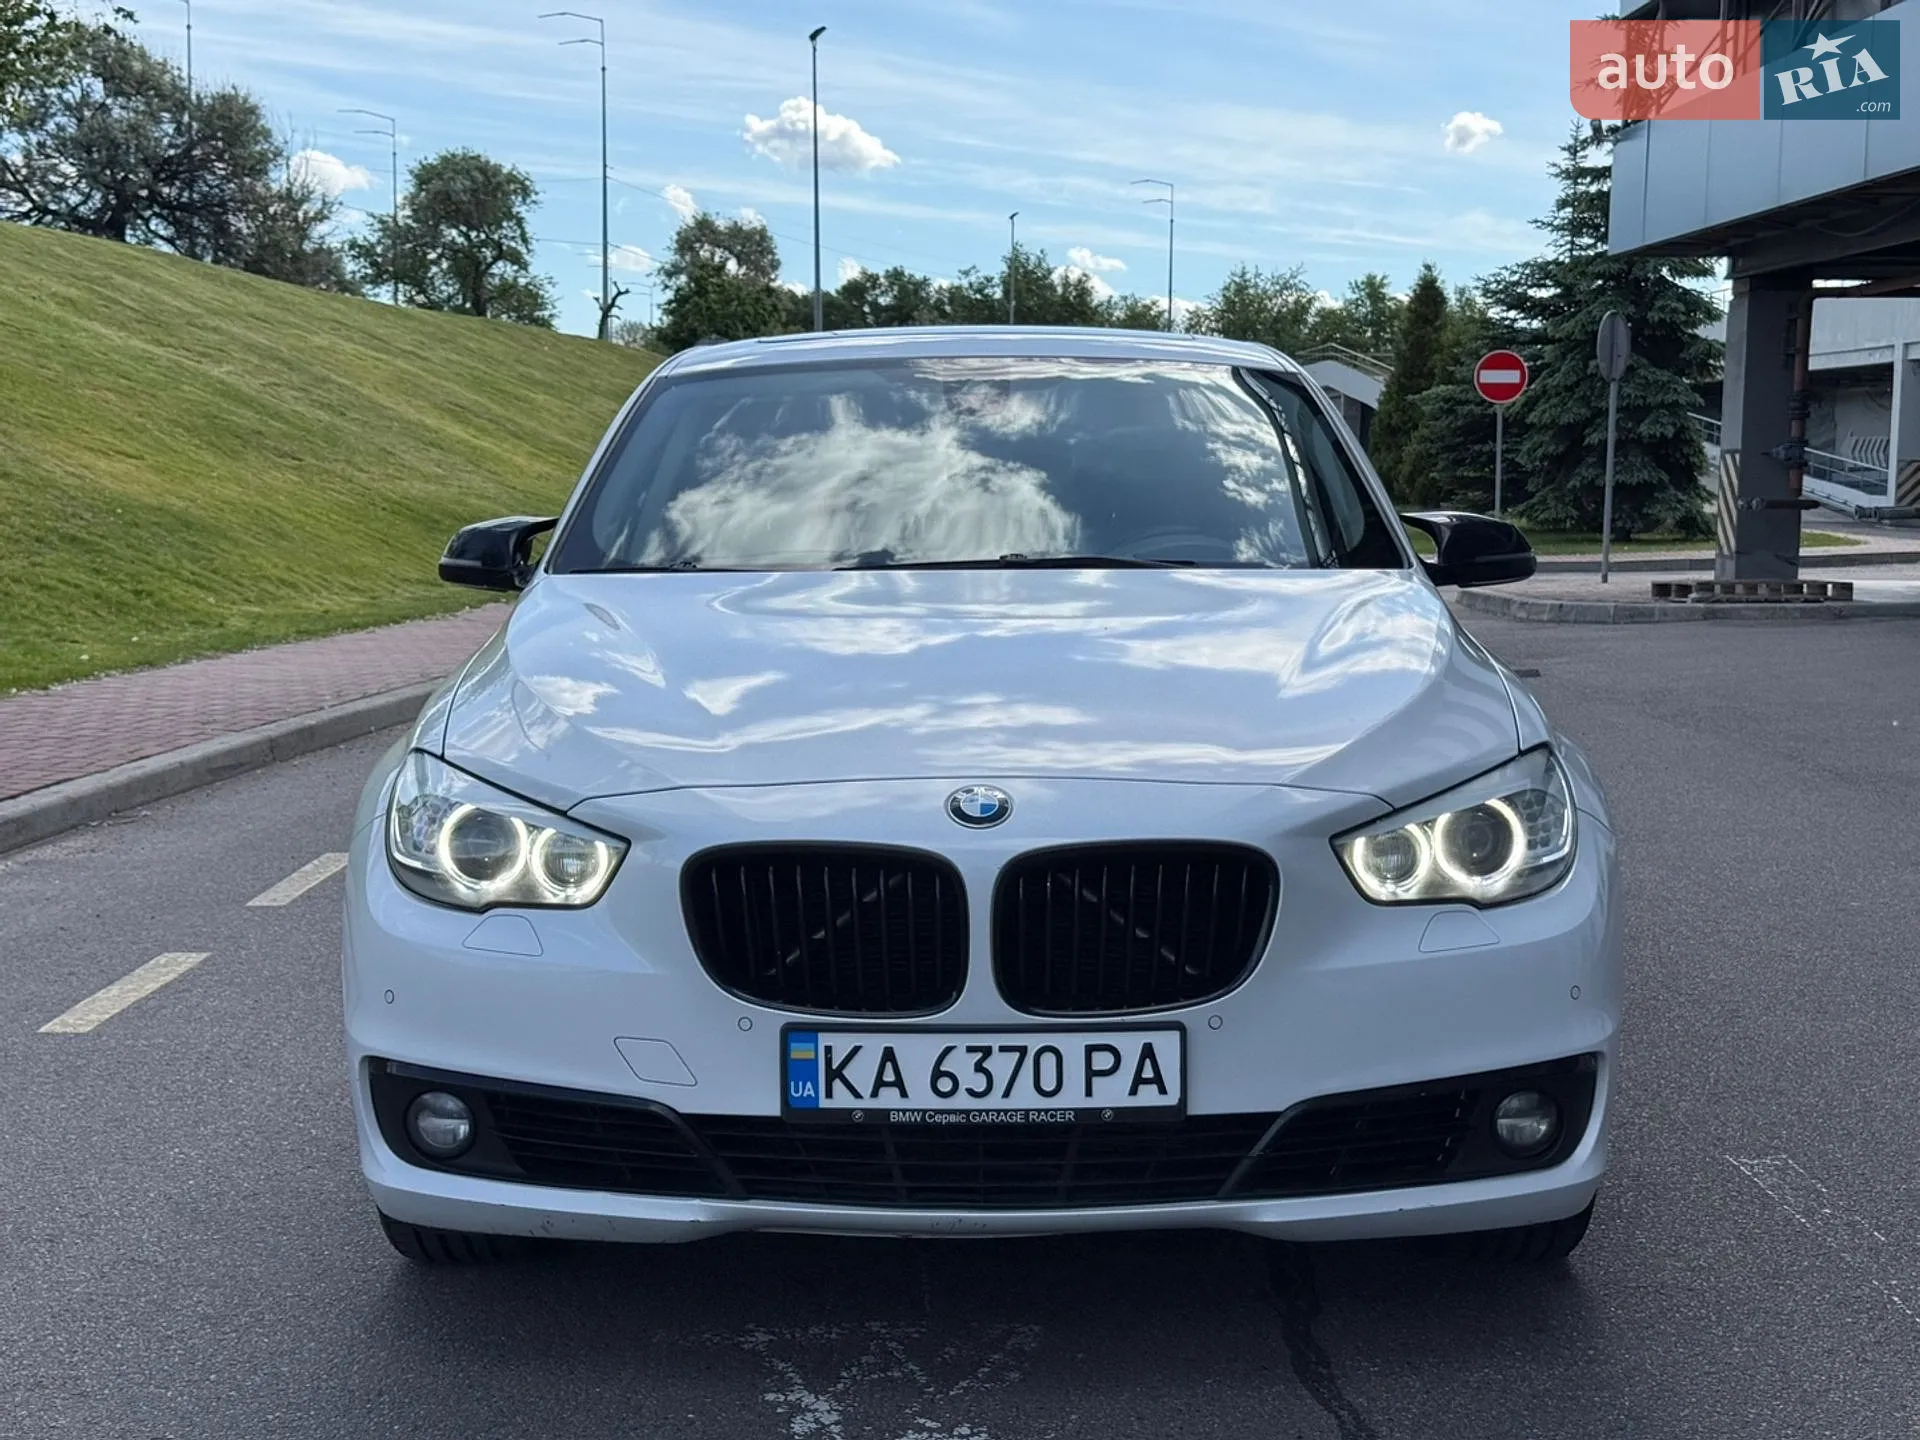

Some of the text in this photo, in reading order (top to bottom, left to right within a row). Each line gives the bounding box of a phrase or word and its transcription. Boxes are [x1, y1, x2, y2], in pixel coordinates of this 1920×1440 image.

[824, 1042, 1168, 1100] KA 6370 PA
[790, 1081, 815, 1098] UA
[890, 1111, 923, 1122] BMW
[969, 1111, 1027, 1123] GARAGE
[1029, 1110, 1075, 1122] RACER
